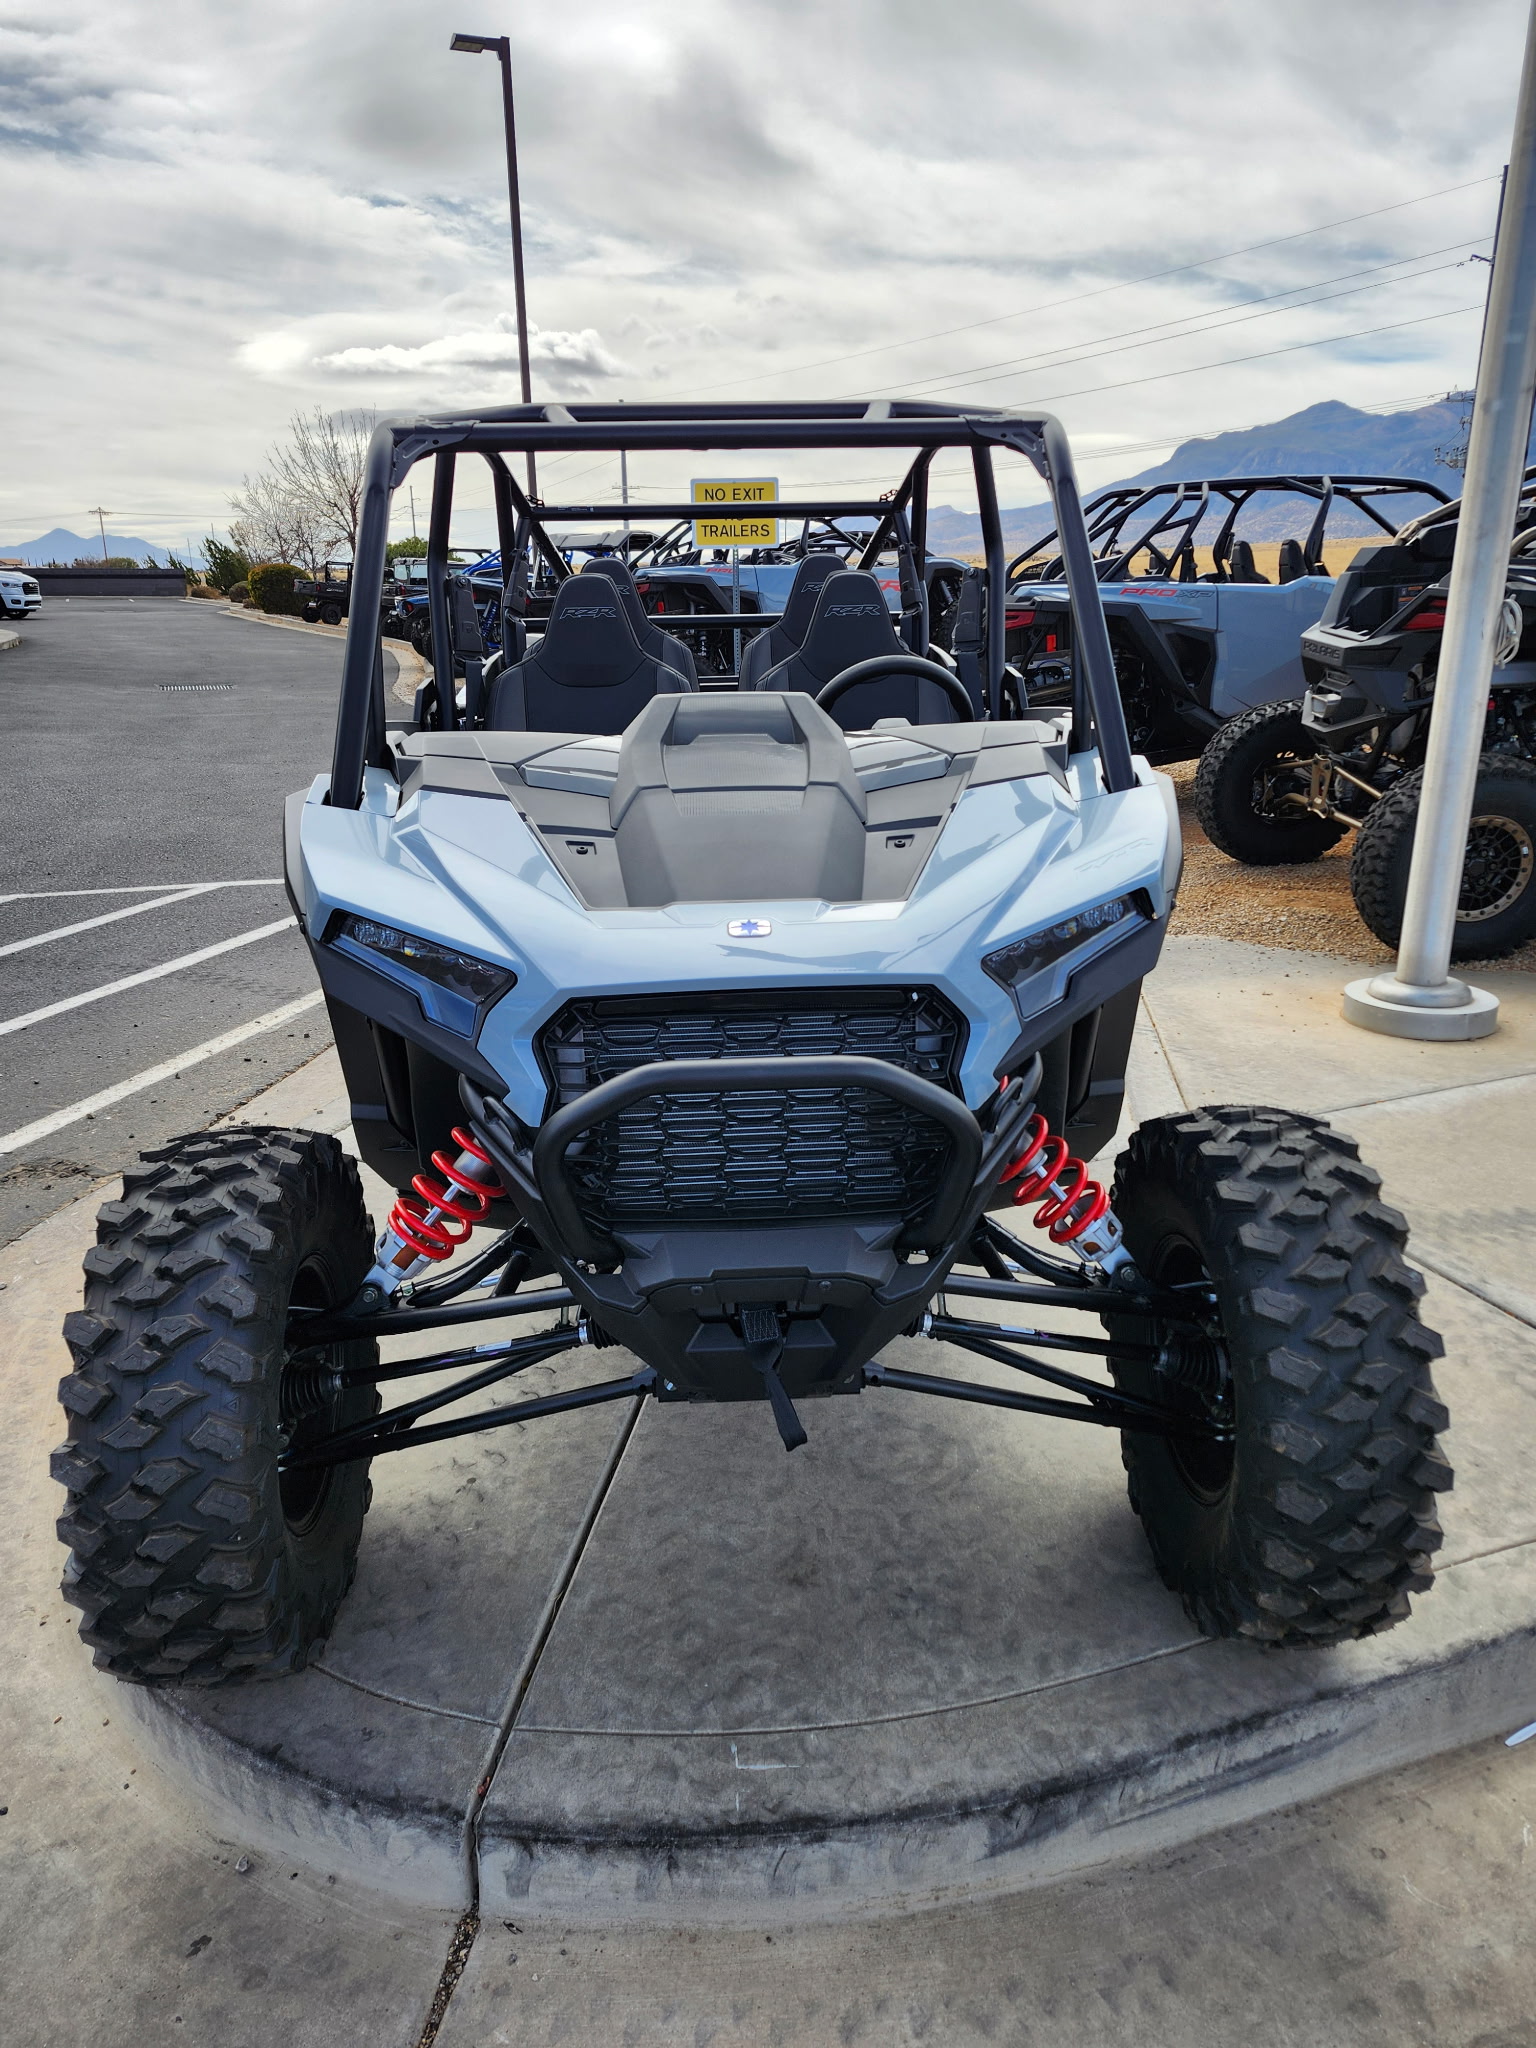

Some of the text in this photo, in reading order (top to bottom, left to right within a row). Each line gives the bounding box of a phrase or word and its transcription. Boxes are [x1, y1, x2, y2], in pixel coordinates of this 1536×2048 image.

[704, 487, 764, 501] NO EXIT
[700, 524, 770, 537] TRAILERS
[1119, 587, 1178, 598] PRO
[560, 606, 617, 620] RZR
[824, 604, 881, 618] RZR
[1303, 640, 1341, 659] POLARIS
